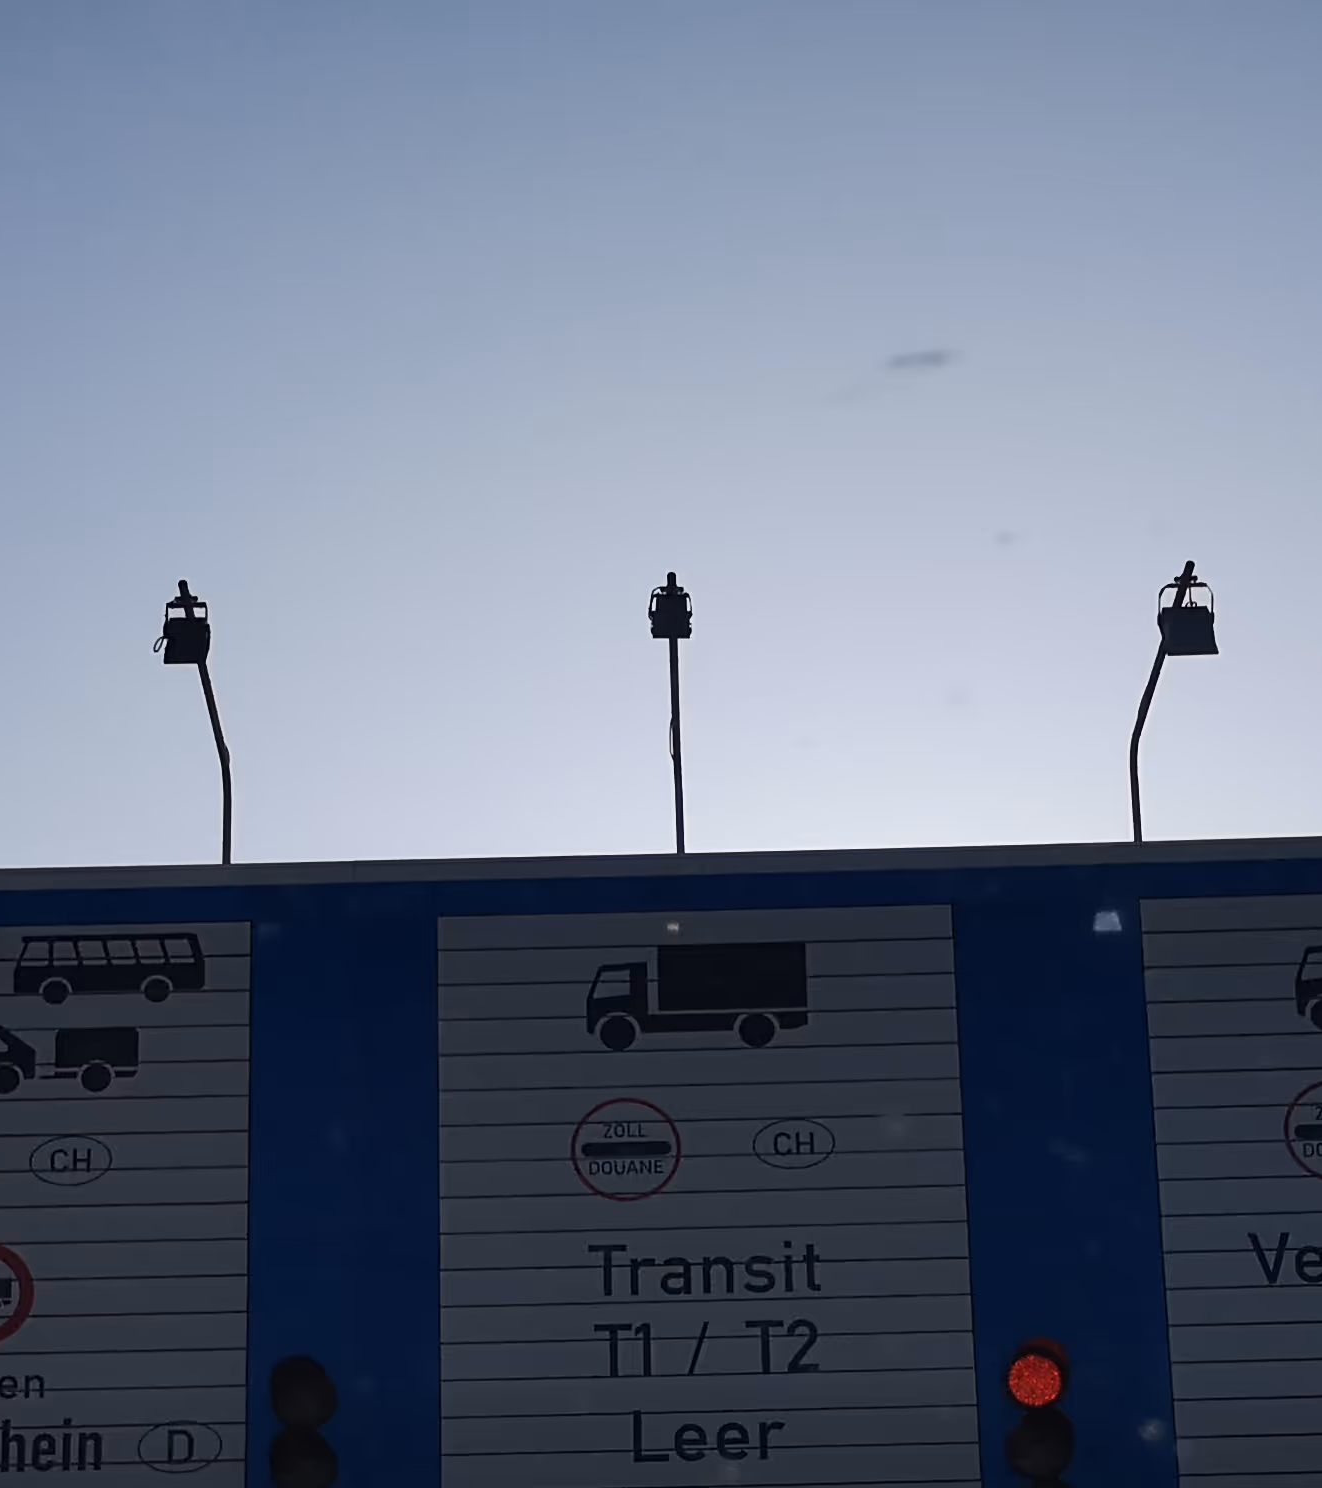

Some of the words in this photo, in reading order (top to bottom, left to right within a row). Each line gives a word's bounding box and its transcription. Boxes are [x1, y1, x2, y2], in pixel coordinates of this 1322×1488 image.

[601, 1121, 647, 1139] ZOLL
[773, 1131, 816, 1157] CH
[48, 1147, 93, 1175] CH
[587, 1158, 665, 1177] DOUANE
[587, 1240, 822, 1297] Transit
[593, 1323, 652, 1378] T1
[744, 1318, 820, 1375] T2
[166, 1430, 196, 1463] D
[632, 1409, 785, 1463] Leer
